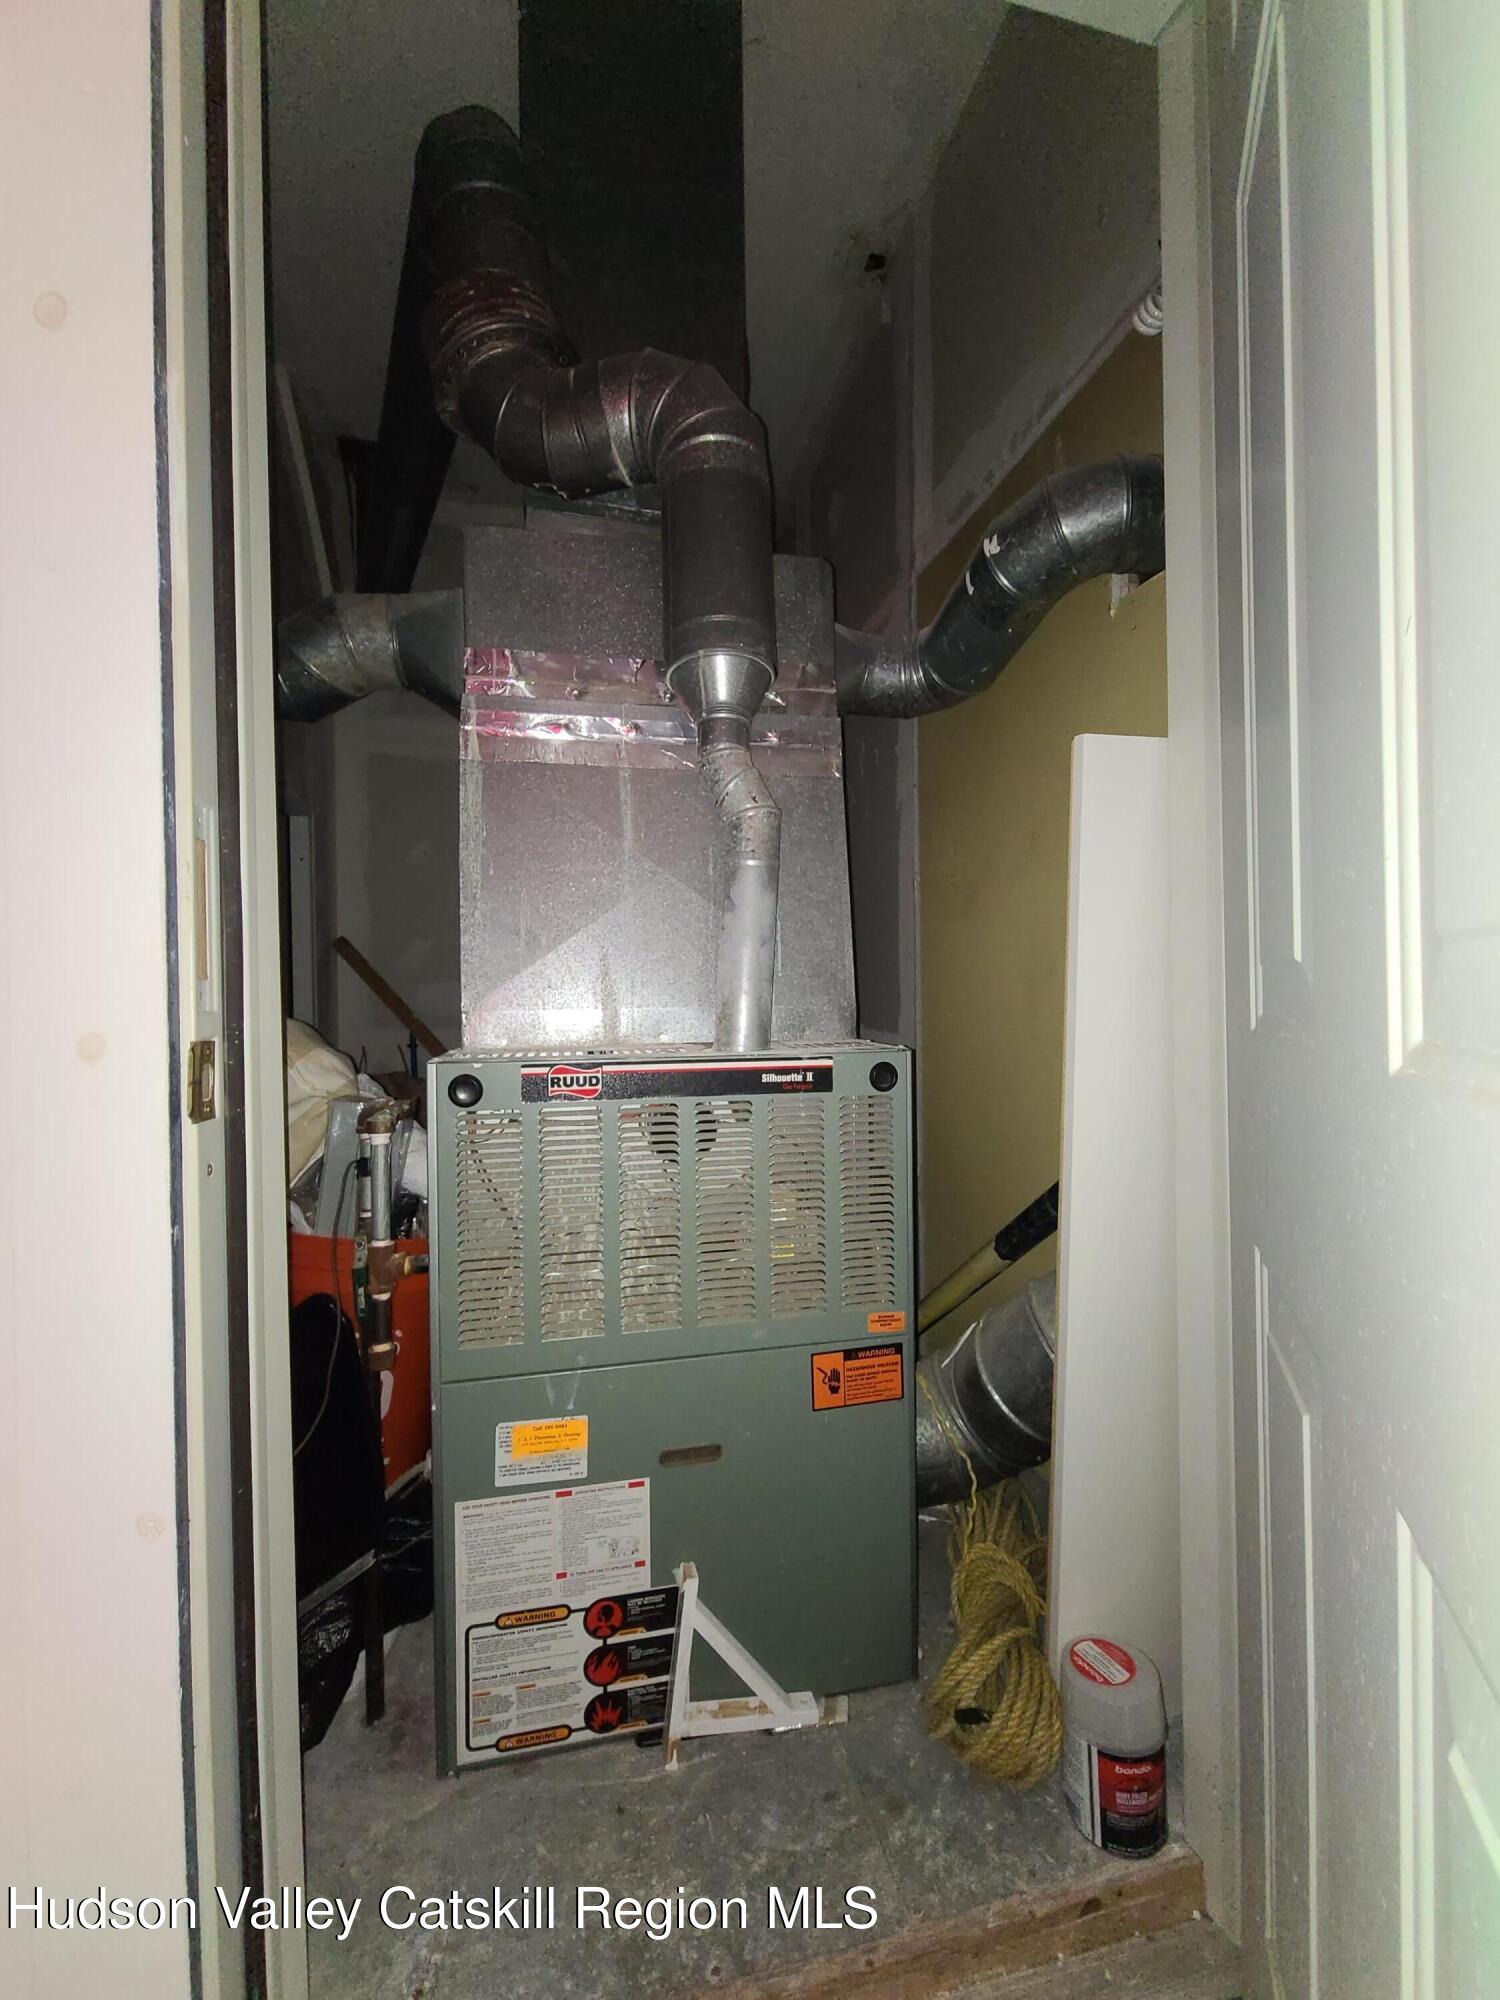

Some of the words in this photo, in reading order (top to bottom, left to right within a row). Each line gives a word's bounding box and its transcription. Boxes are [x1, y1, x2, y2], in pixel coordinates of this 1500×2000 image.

[550, 1075, 601, 1088] RUUD
[761, 1072, 803, 1083] Silhouette
[806, 1071, 814, 1082] II
[858, 1347, 895, 1358] WARNING
[514, 1611, 557, 1623] WARNING
[515, 1733, 557, 1745] WARNING
